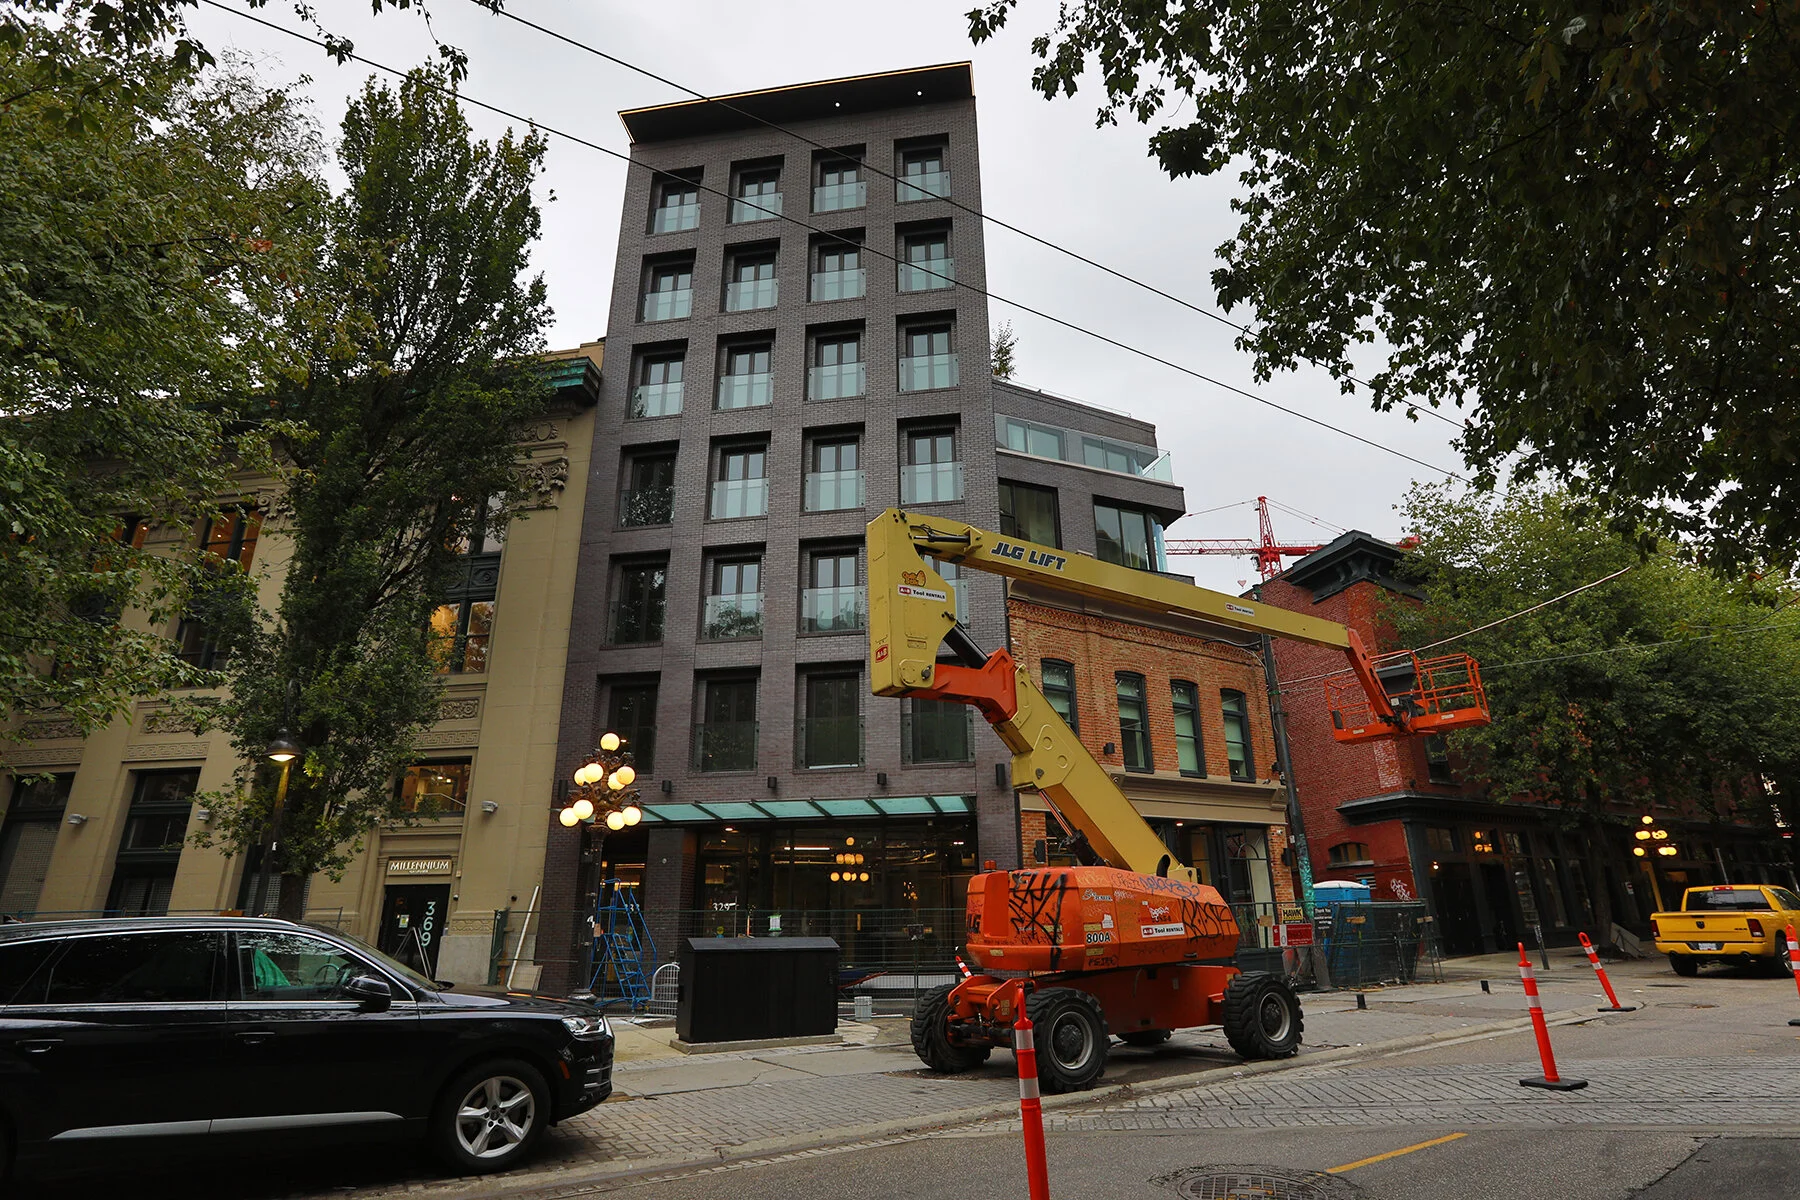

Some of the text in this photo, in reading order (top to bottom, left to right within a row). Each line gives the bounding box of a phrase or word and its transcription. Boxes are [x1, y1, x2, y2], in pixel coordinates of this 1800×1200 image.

[990, 541, 1067, 571] JLG LIFT
[926, 592, 945, 600] RENTALS
[390, 861, 449, 871] MILLENNIUM
[712, 902, 730, 912] 329
[1282, 908, 1302, 917] HAWK
[421, 901, 436, 947] 369
[1086, 931, 1111, 944] 800A
